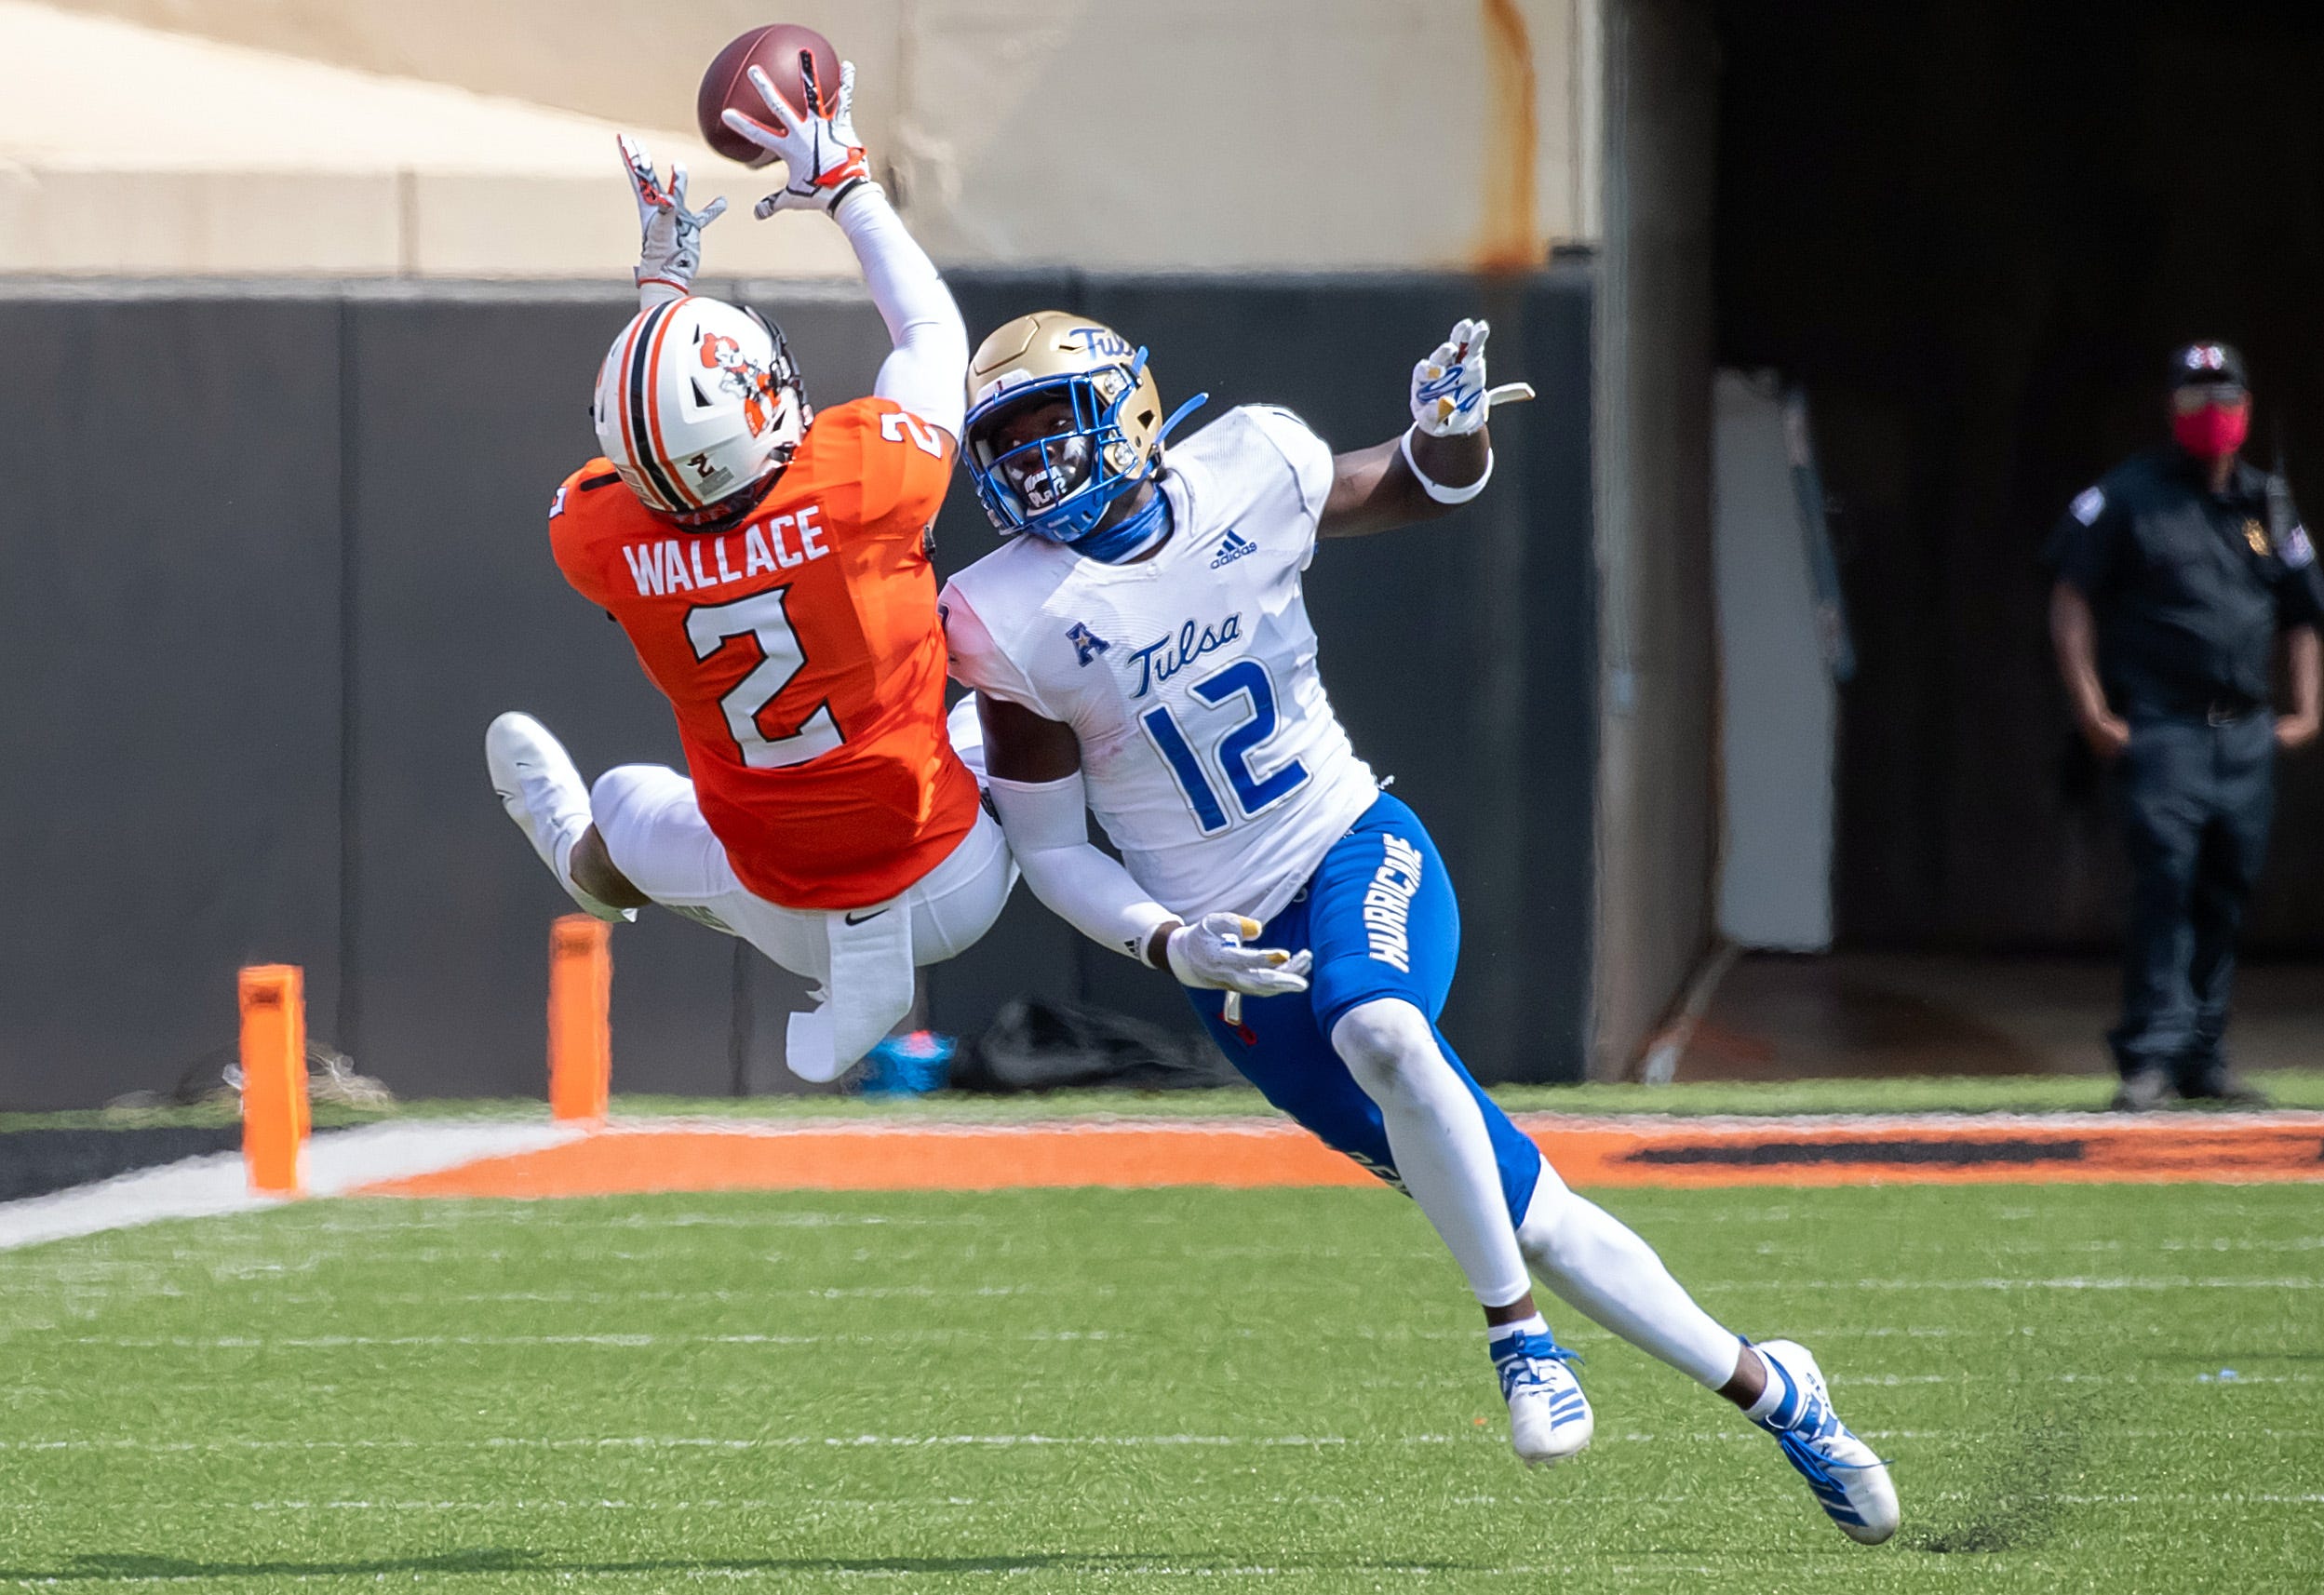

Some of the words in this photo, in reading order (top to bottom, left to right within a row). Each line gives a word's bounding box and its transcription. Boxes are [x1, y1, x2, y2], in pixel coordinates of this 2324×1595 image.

[687, 452, 715, 478] 2
[880, 412, 943, 459] 2
[622, 505, 830, 597] WALLACE
[1211, 542, 1257, 570] adidas
[682, 583, 845, 770] 2
[1128, 611, 1243, 699] Tulsa
[1137, 654, 1313, 838] 12
[1363, 833, 1423, 974] HURRICANE
